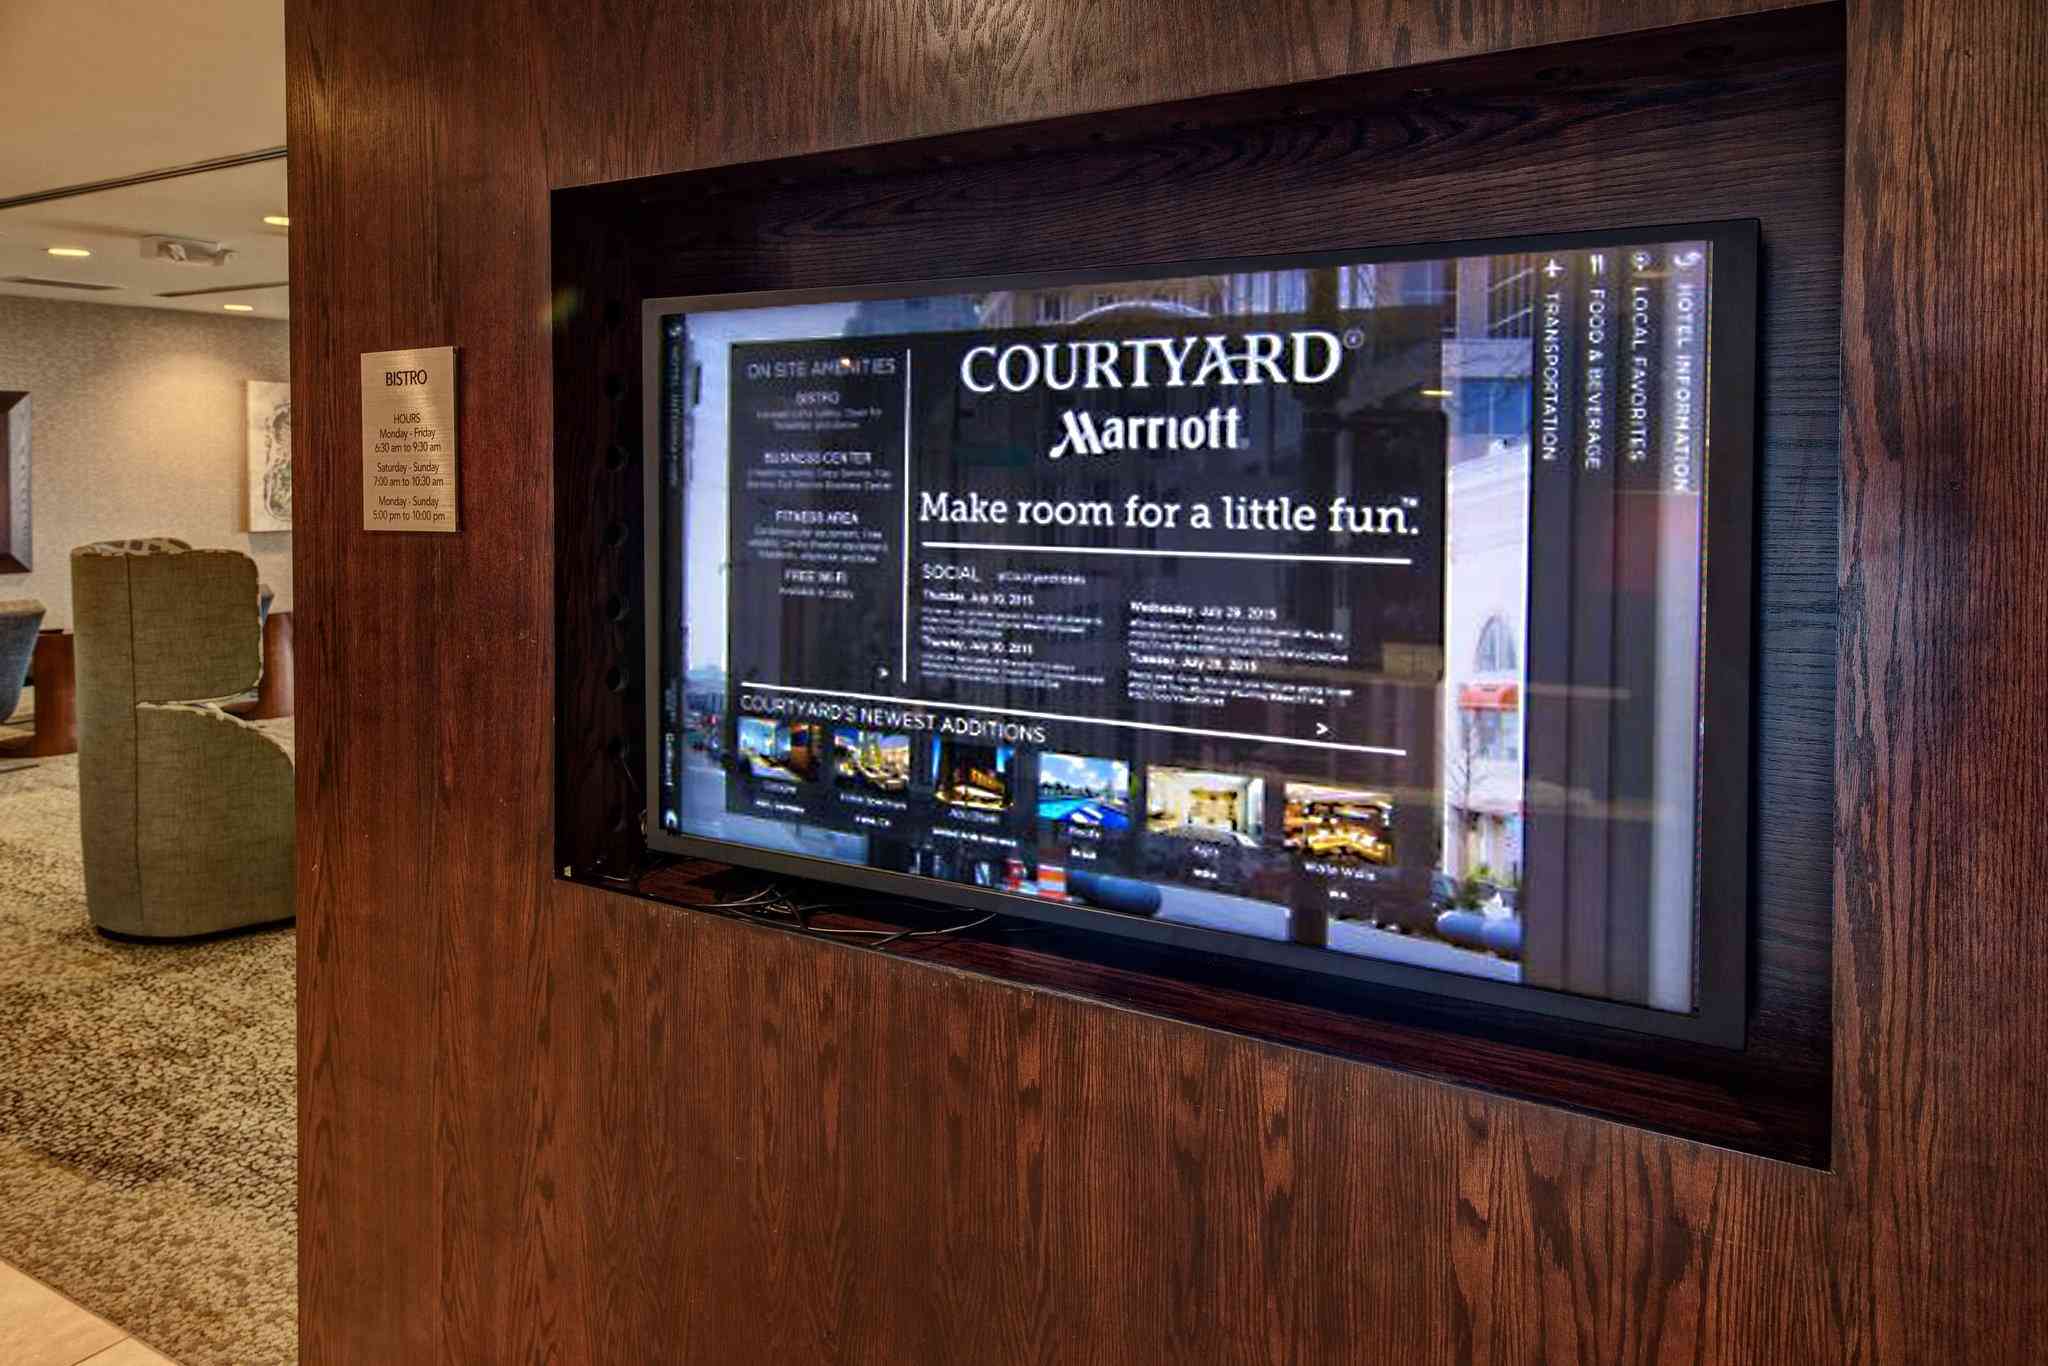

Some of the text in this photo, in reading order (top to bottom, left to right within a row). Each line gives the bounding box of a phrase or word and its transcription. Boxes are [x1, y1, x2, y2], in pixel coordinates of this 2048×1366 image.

[1589, 289, 1605, 343] FOOD
[961, 331, 1343, 393] COURTYARD
[385, 369, 428, 386] BISTRO
[1542, 292, 1560, 460] TRANSPORTATION
[1629, 287, 1648, 463] LOCAL FAVORITES
[393, 412, 421, 425] HOURS
[379, 429, 408, 441] Monday
[414, 427, 436, 439] Friday
[1049, 407, 1241, 459] Marriott
[391, 443, 401, 453] am
[403, 443, 412, 452] to
[413, 441, 428, 452] 9:30
[429, 441, 441, 451] am
[377, 461, 408, 473] Saturday
[413, 461, 440, 475] Sunday
[374, 475, 444, 487] 7:00 am to 10:30 am
[378, 496, 407, 509] Monday
[412, 495, 439, 509] Sunday
[373, 510, 446, 523] 5:00 pm to 10:00 pm
[919, 493, 1009, 523] Make
[1017, 502, 1115, 526] room
[1124, 495, 1181, 529] for
[1190, 506, 1212, 530] a
[1221, 497, 1318, 533] little
[922, 563, 980, 582] SOCIAL
[740, 695, 1048, 744] COURTYARD'S NEWEST ADDITIONS
